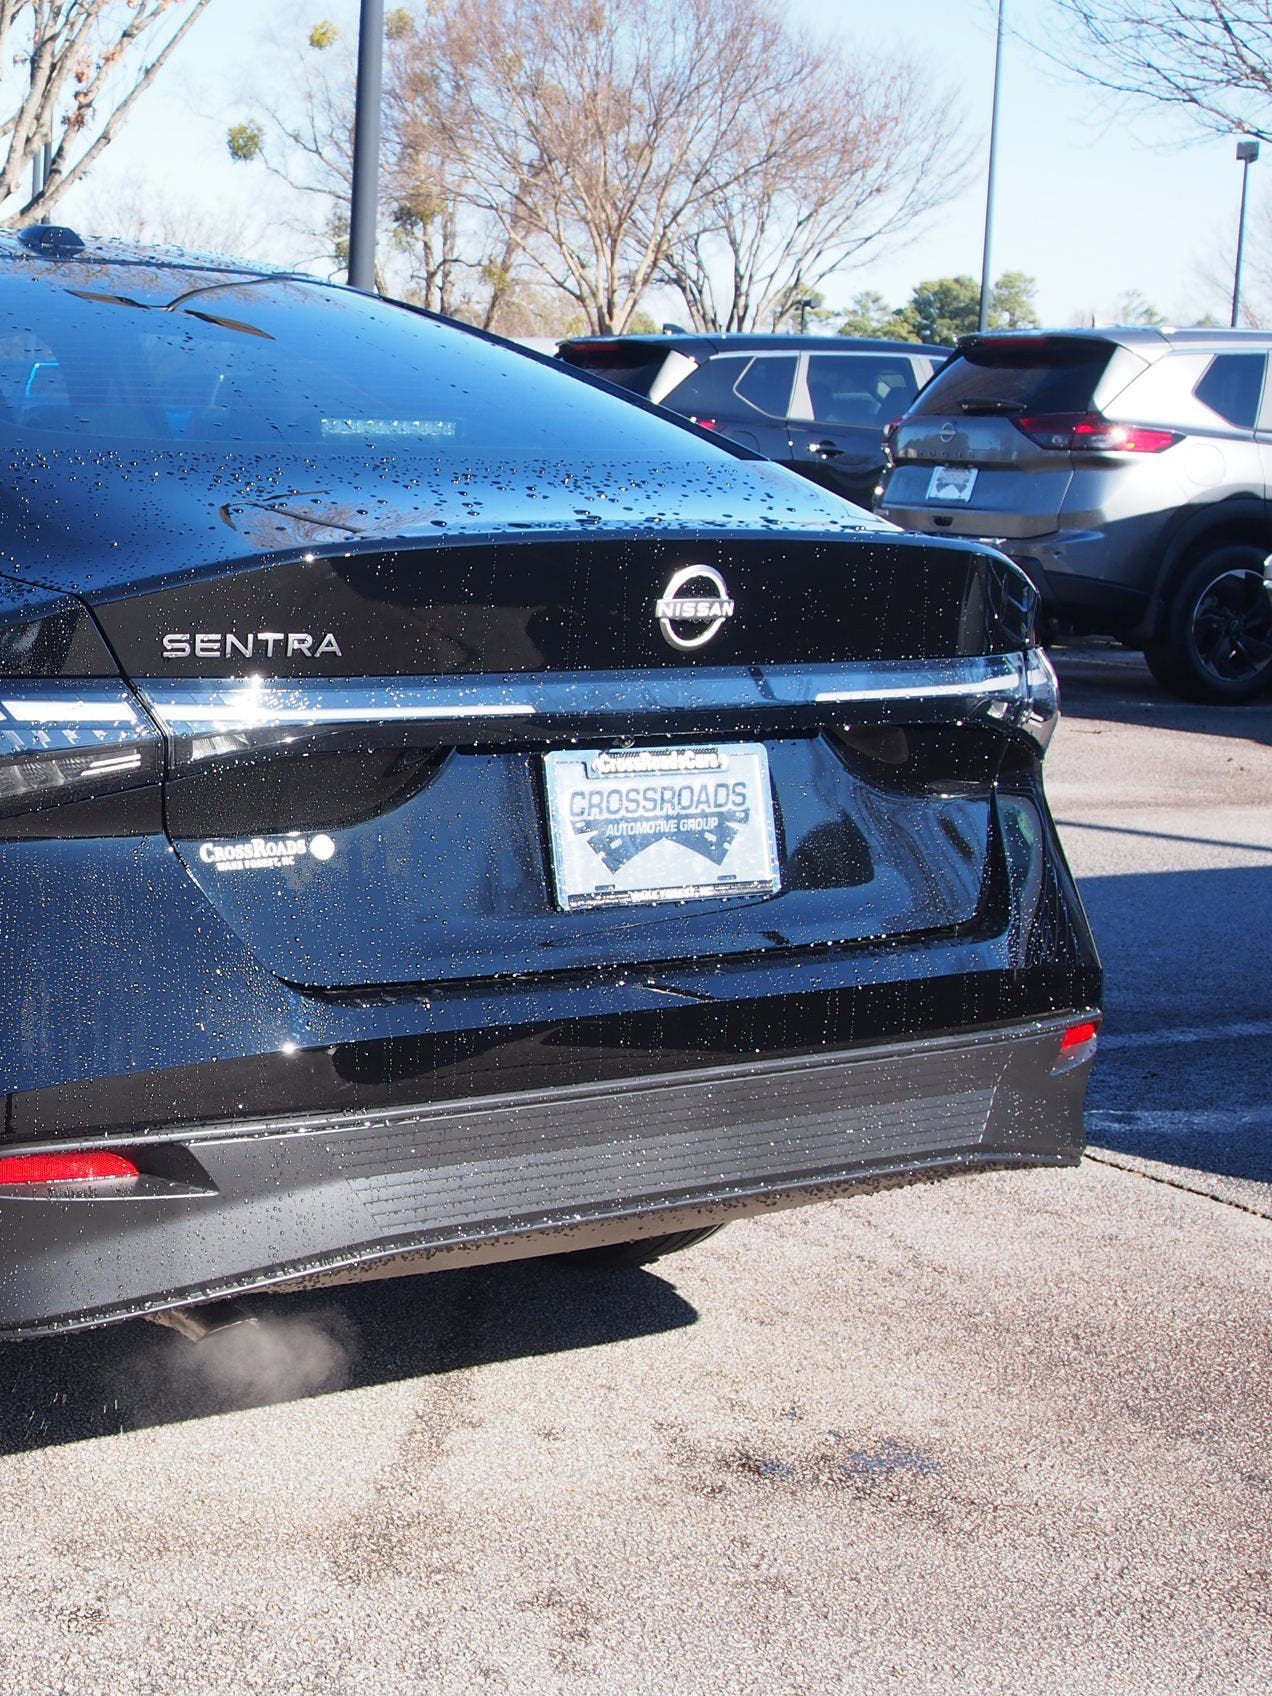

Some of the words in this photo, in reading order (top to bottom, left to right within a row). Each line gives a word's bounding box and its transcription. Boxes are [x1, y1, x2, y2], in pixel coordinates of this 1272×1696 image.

[658, 602, 734, 617] NISSAN
[162, 632, 343, 658] SENTRA
[569, 781, 748, 818] CROSSROADS
[606, 820, 678, 837] AUTOMOTIVE
[680, 817, 719, 832] GROUP
[216, 860, 244, 871] WAKE
[282, 856, 295, 866] NC
